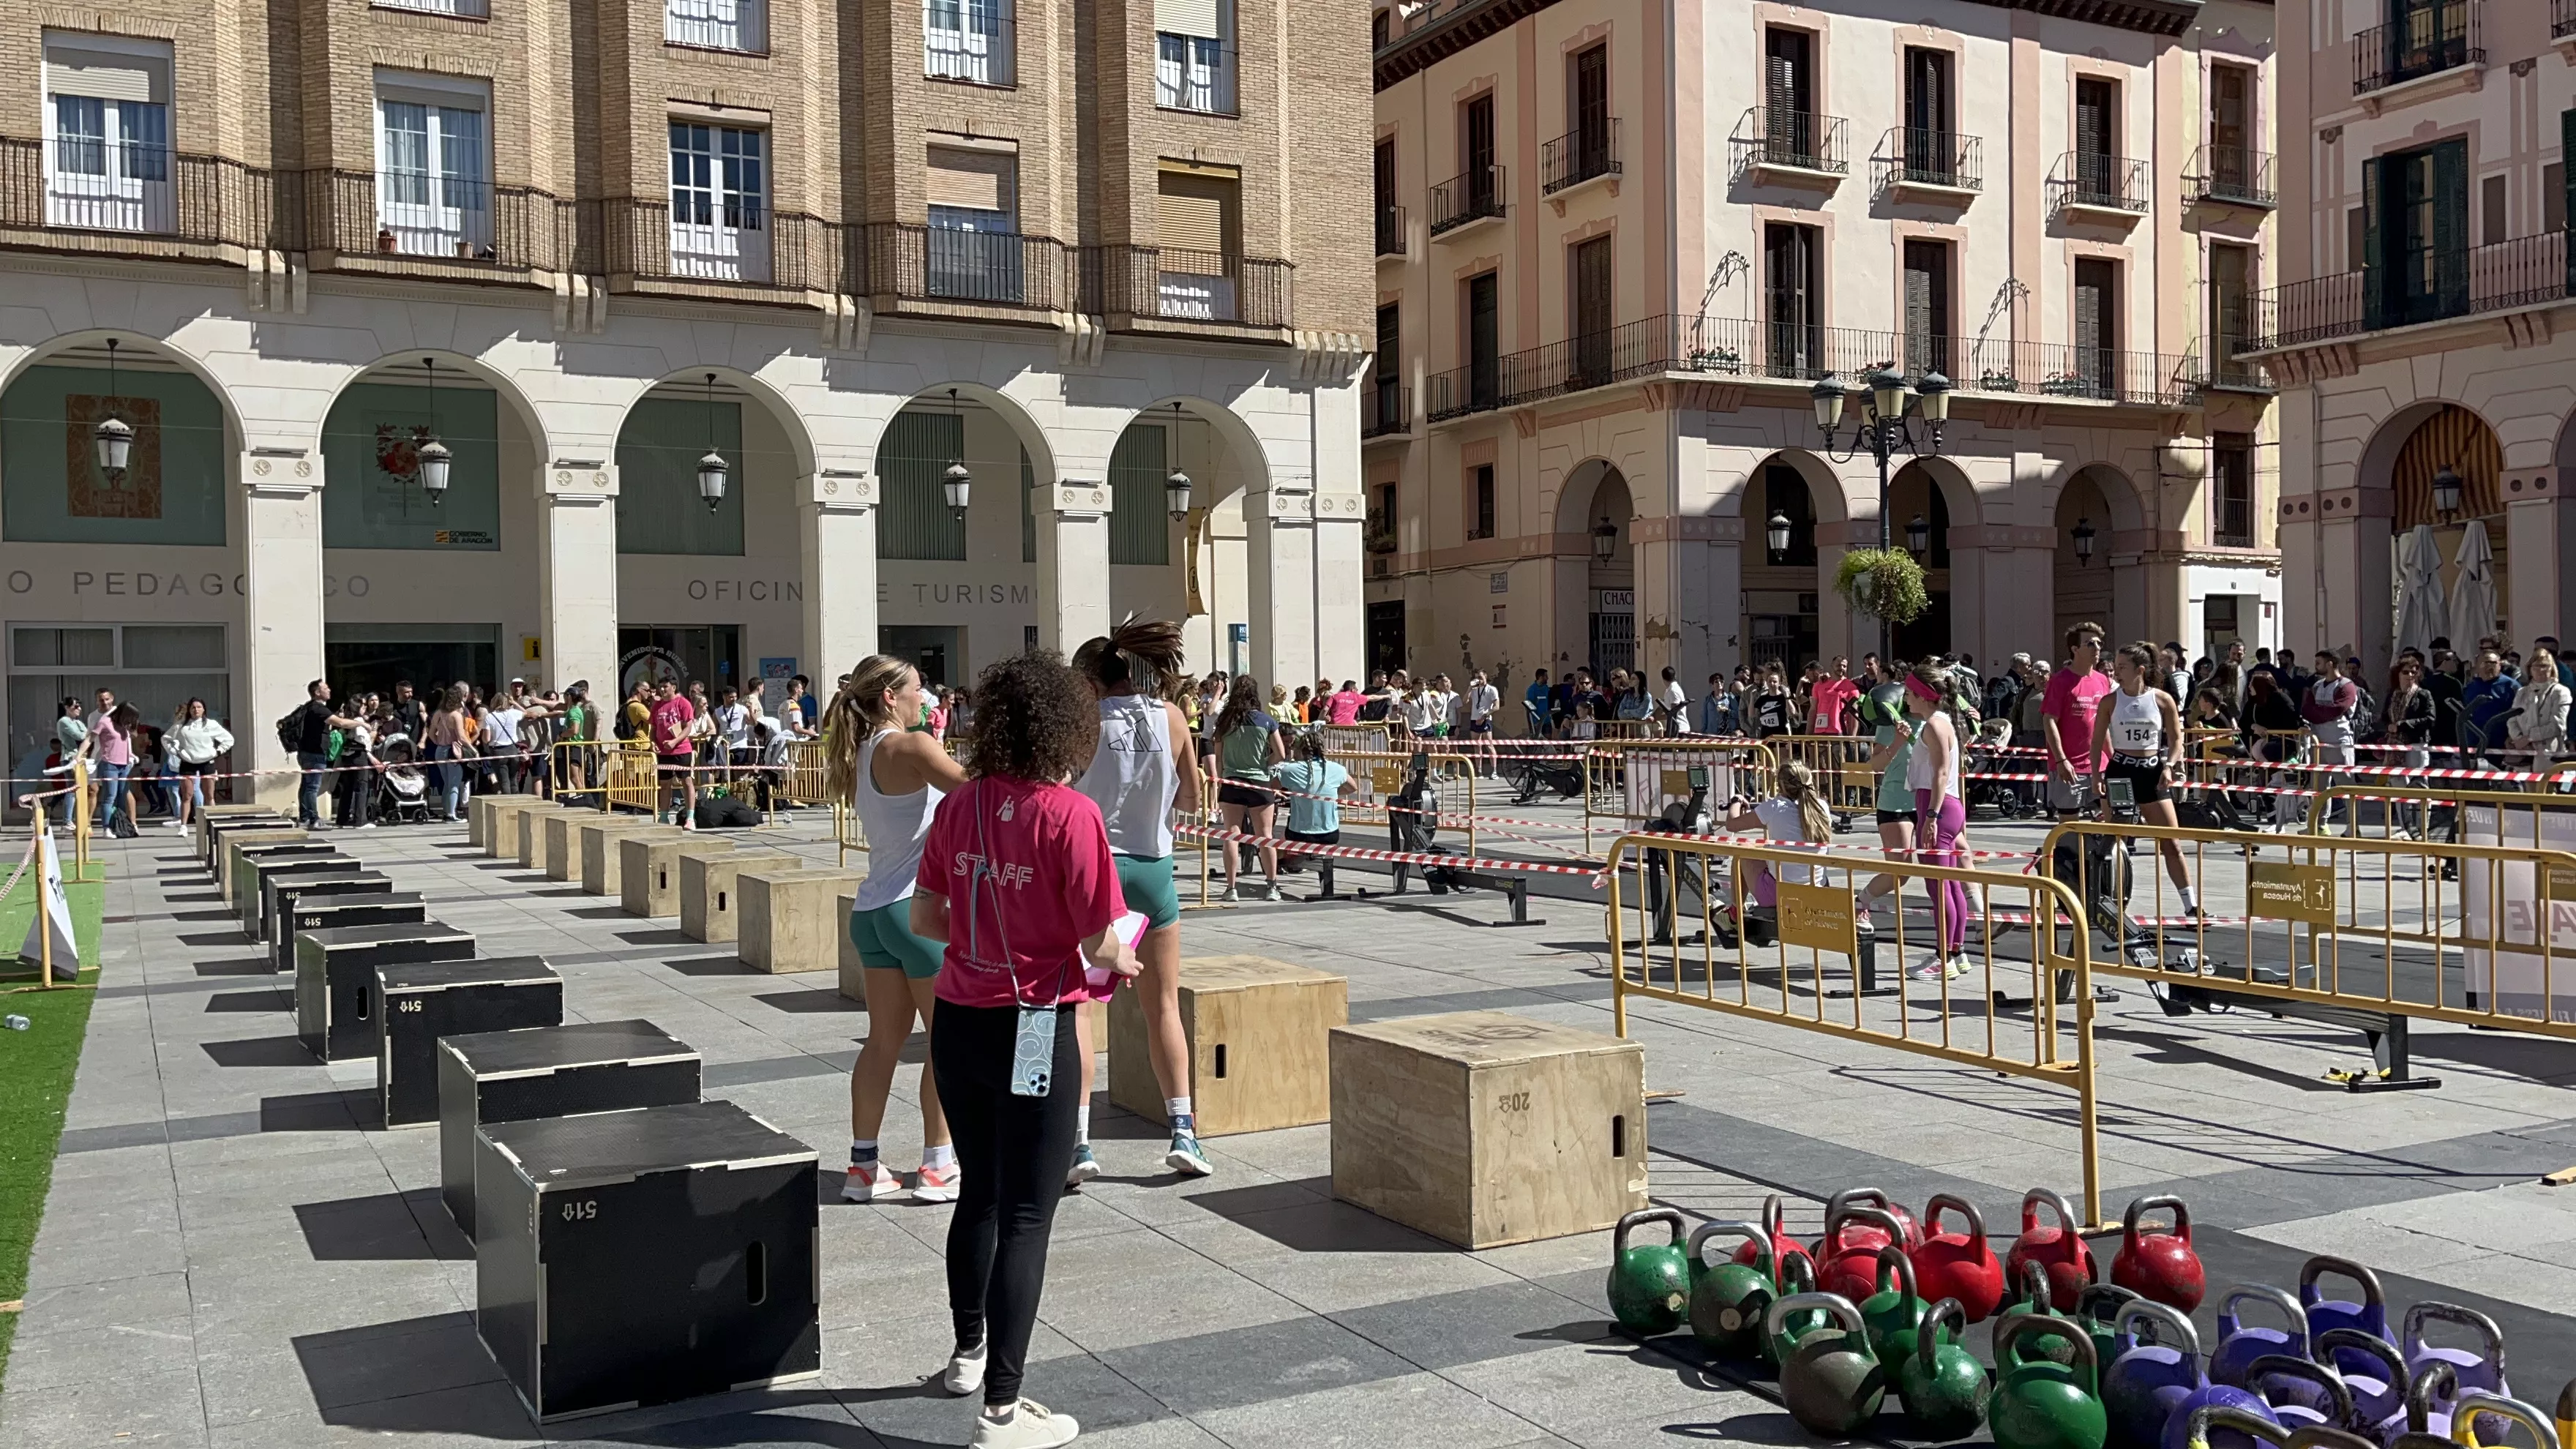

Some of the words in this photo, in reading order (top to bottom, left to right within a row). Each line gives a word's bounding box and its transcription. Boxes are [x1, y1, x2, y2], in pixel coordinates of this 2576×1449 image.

[73, 571, 370, 598] PEDAGCO
[687, 580, 803, 601] OFICIN
[1604, 591, 1634, 605] CHACI
[2125, 728, 2150, 741] 154
[2123, 755, 2159, 768] PRO
[953, 851, 1034, 891] STAFF
[408, 1000, 422, 1013] 51
[1511, 1091, 1531, 1112] 20
[576, 1200, 598, 1221] 51
